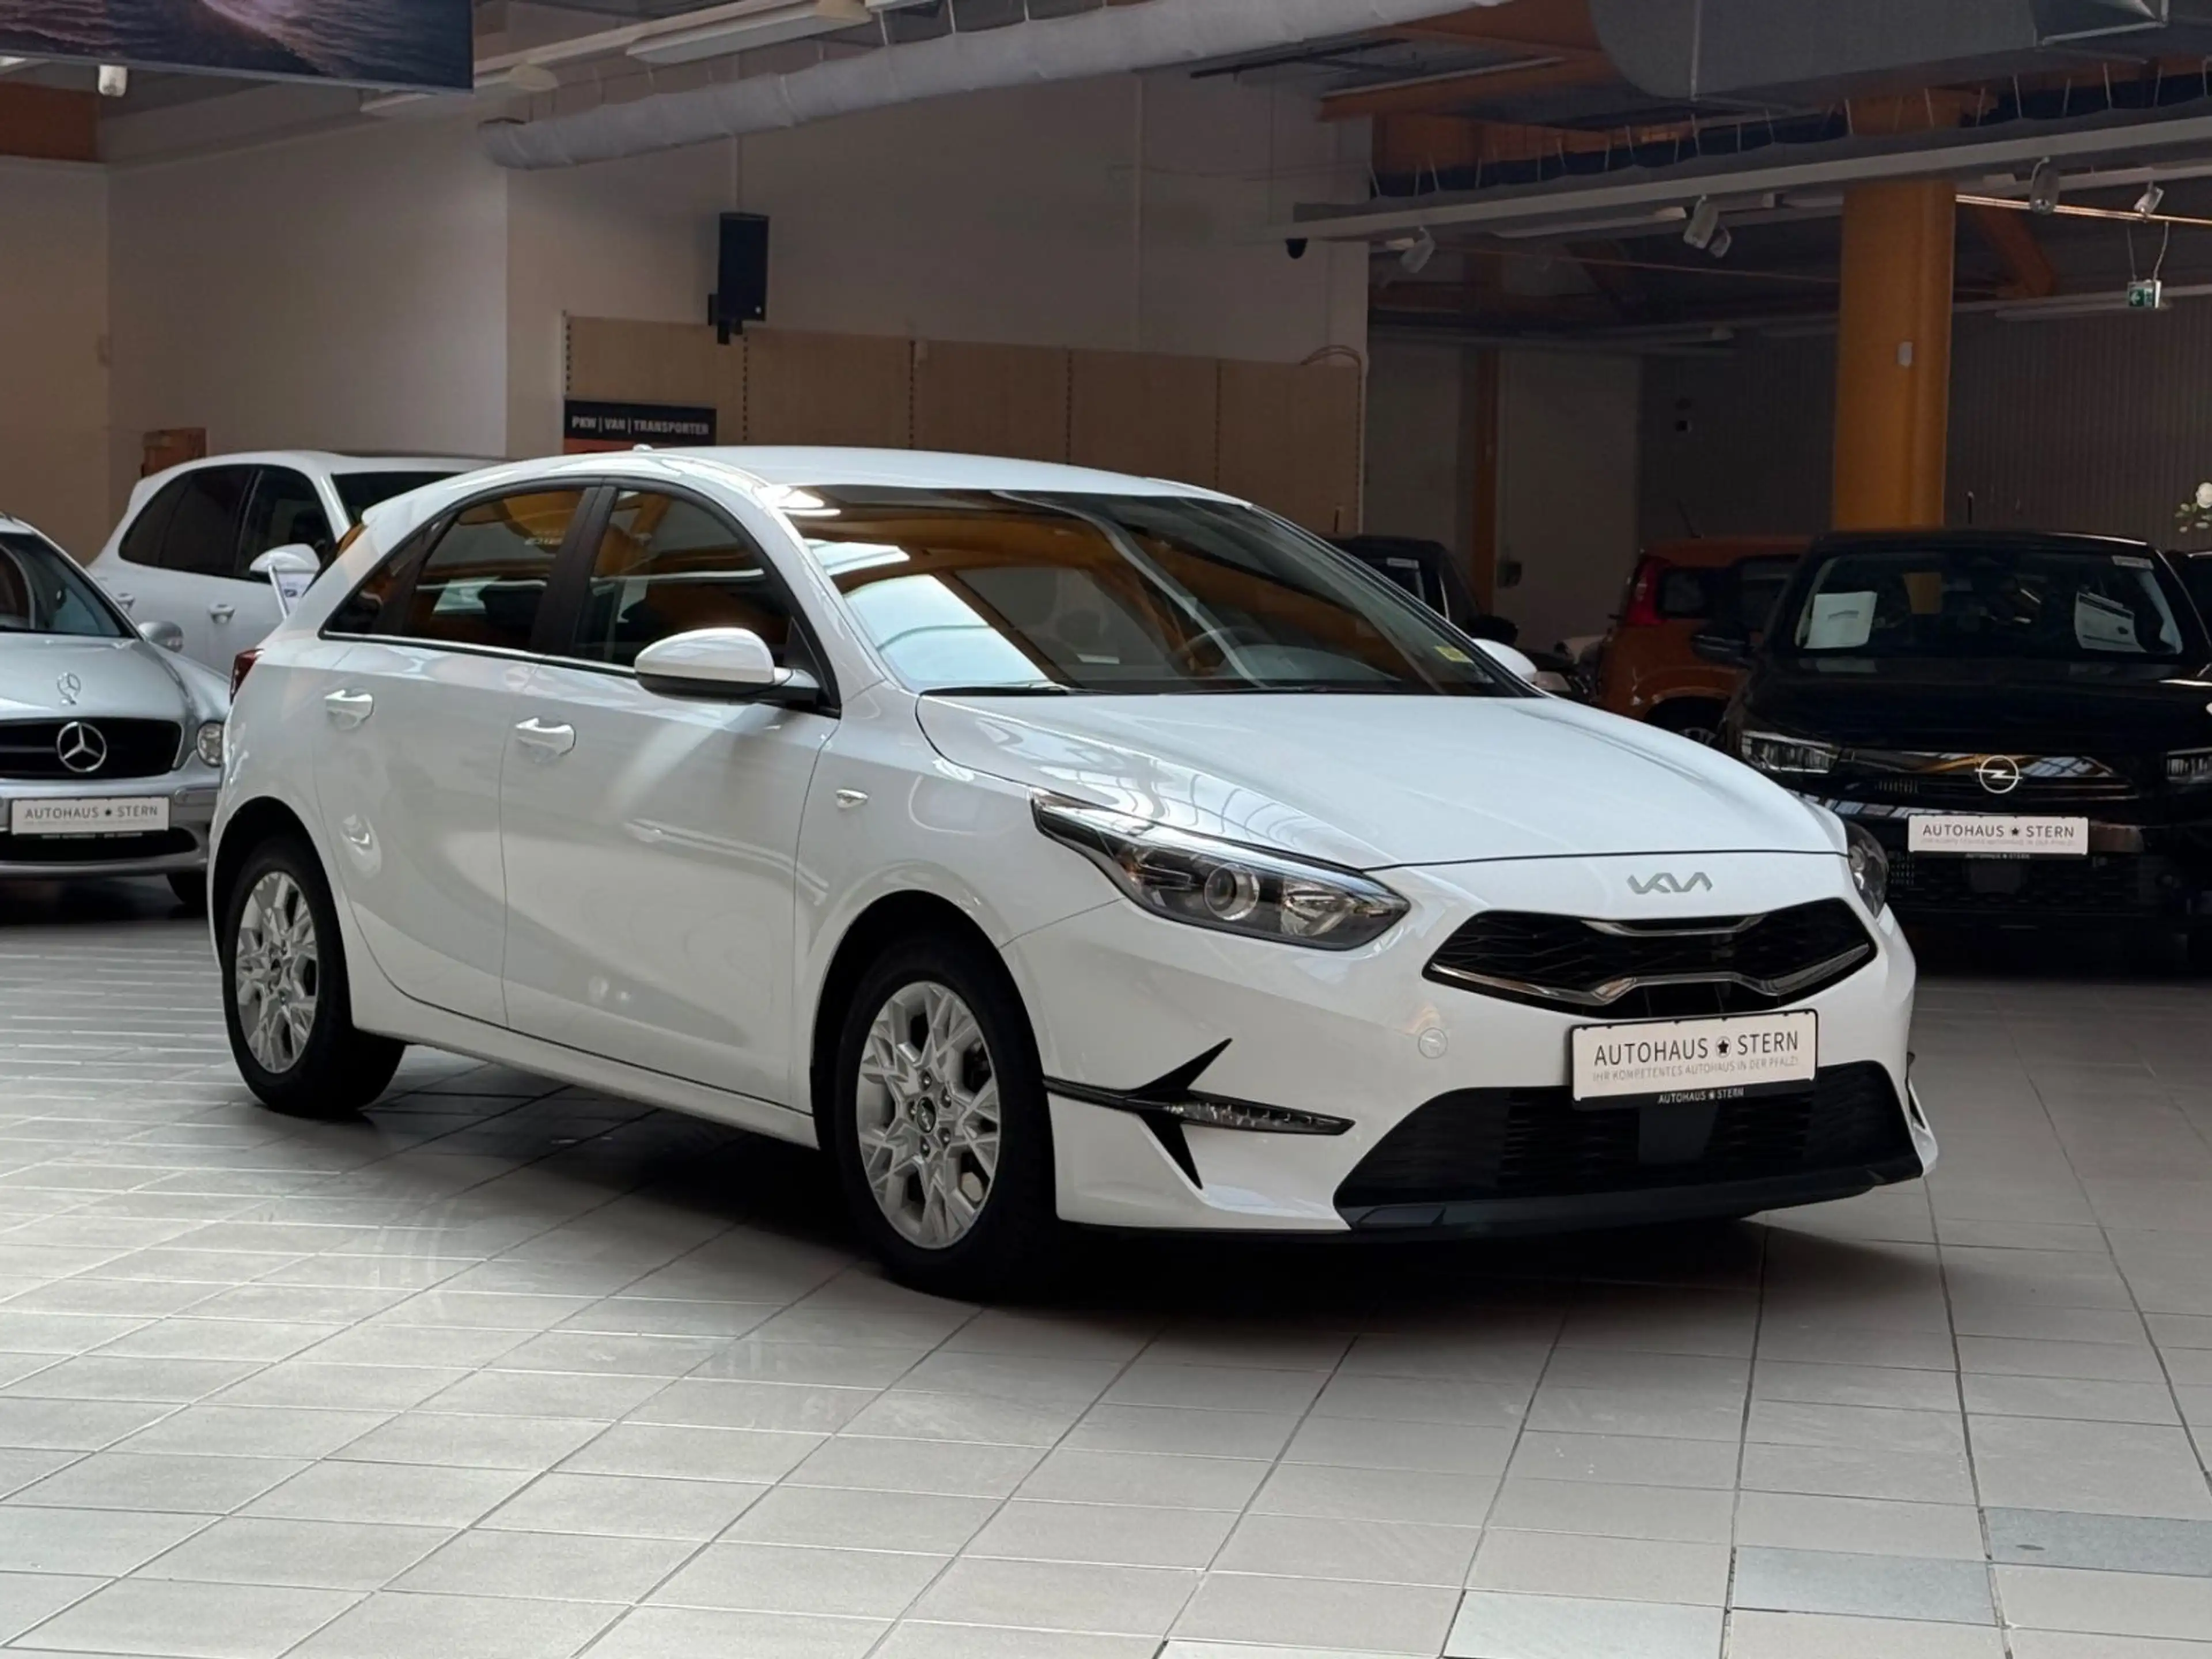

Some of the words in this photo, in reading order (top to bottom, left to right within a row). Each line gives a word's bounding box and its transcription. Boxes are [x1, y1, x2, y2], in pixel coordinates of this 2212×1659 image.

[571, 415, 596, 429] PKW
[605, 418, 626, 430] VAN
[634, 420, 709, 434] TRANSPORTER
[25, 807, 100, 819] AUTOHAUS
[117, 806, 158, 817] STERN
[1923, 824, 2005, 837] AUTOHAUS
[2026, 825, 2074, 838] STERN
[1594, 1037, 1708, 1066] AUTOHAUS
[1737, 1030, 1798, 1056] STERN
[1593, 1071, 1611, 1082] IHR
[1612, 1066, 1683, 1081] KOMPETENTES
[1685, 1060, 1736, 1074] AUTOHAUS
[1657, 1090, 1707, 1104] AUTOHAUS
[1716, 1087, 1744, 1099] STERN
